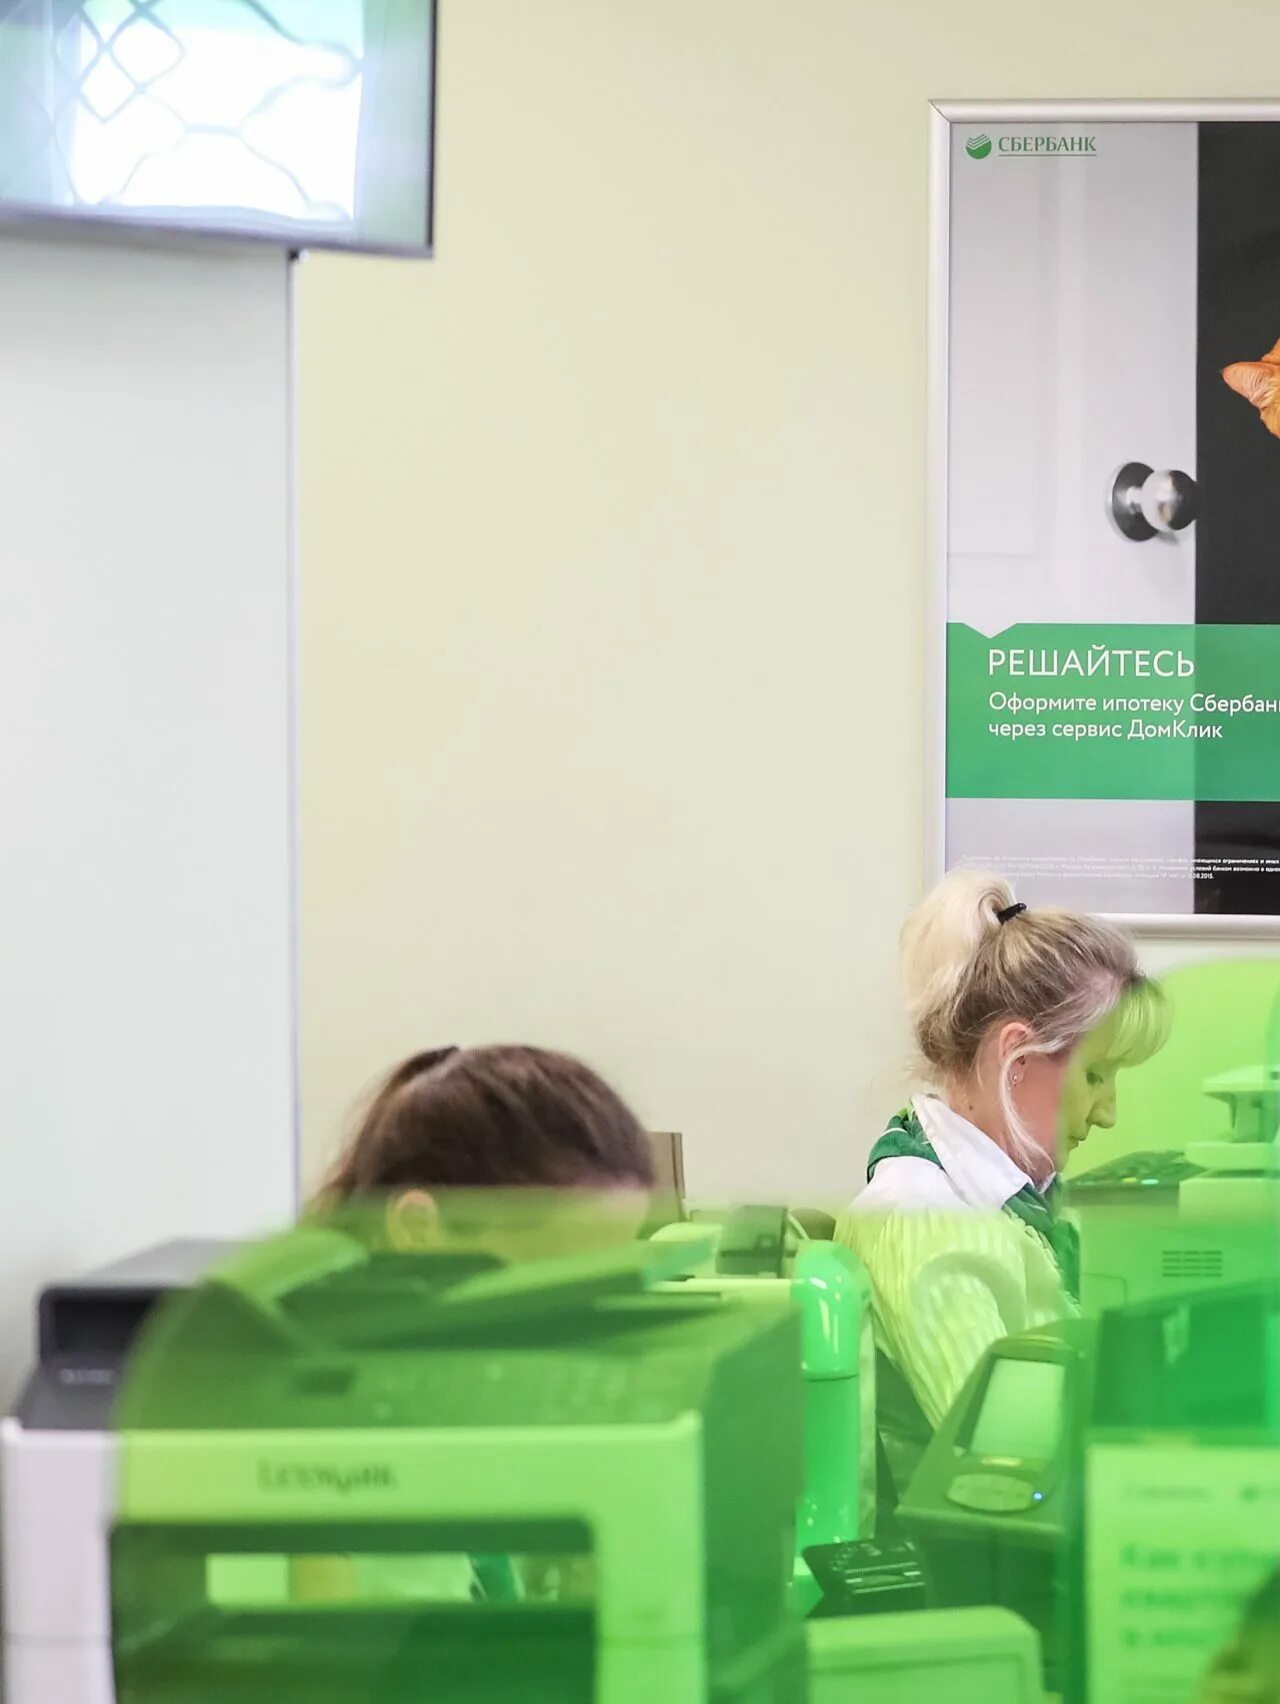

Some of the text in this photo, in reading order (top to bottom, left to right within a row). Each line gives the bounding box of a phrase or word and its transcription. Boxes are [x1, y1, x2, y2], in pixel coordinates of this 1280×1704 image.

[998, 136, 1096, 152] СБЕРБАНК
[988, 645, 1195, 677] РЕШАЙТЕСЬ
[988, 692, 1097, 714] Оформите
[1103, 697, 1184, 715] ипотеку
[988, 719, 1223, 741] через сервис ДомКлик
